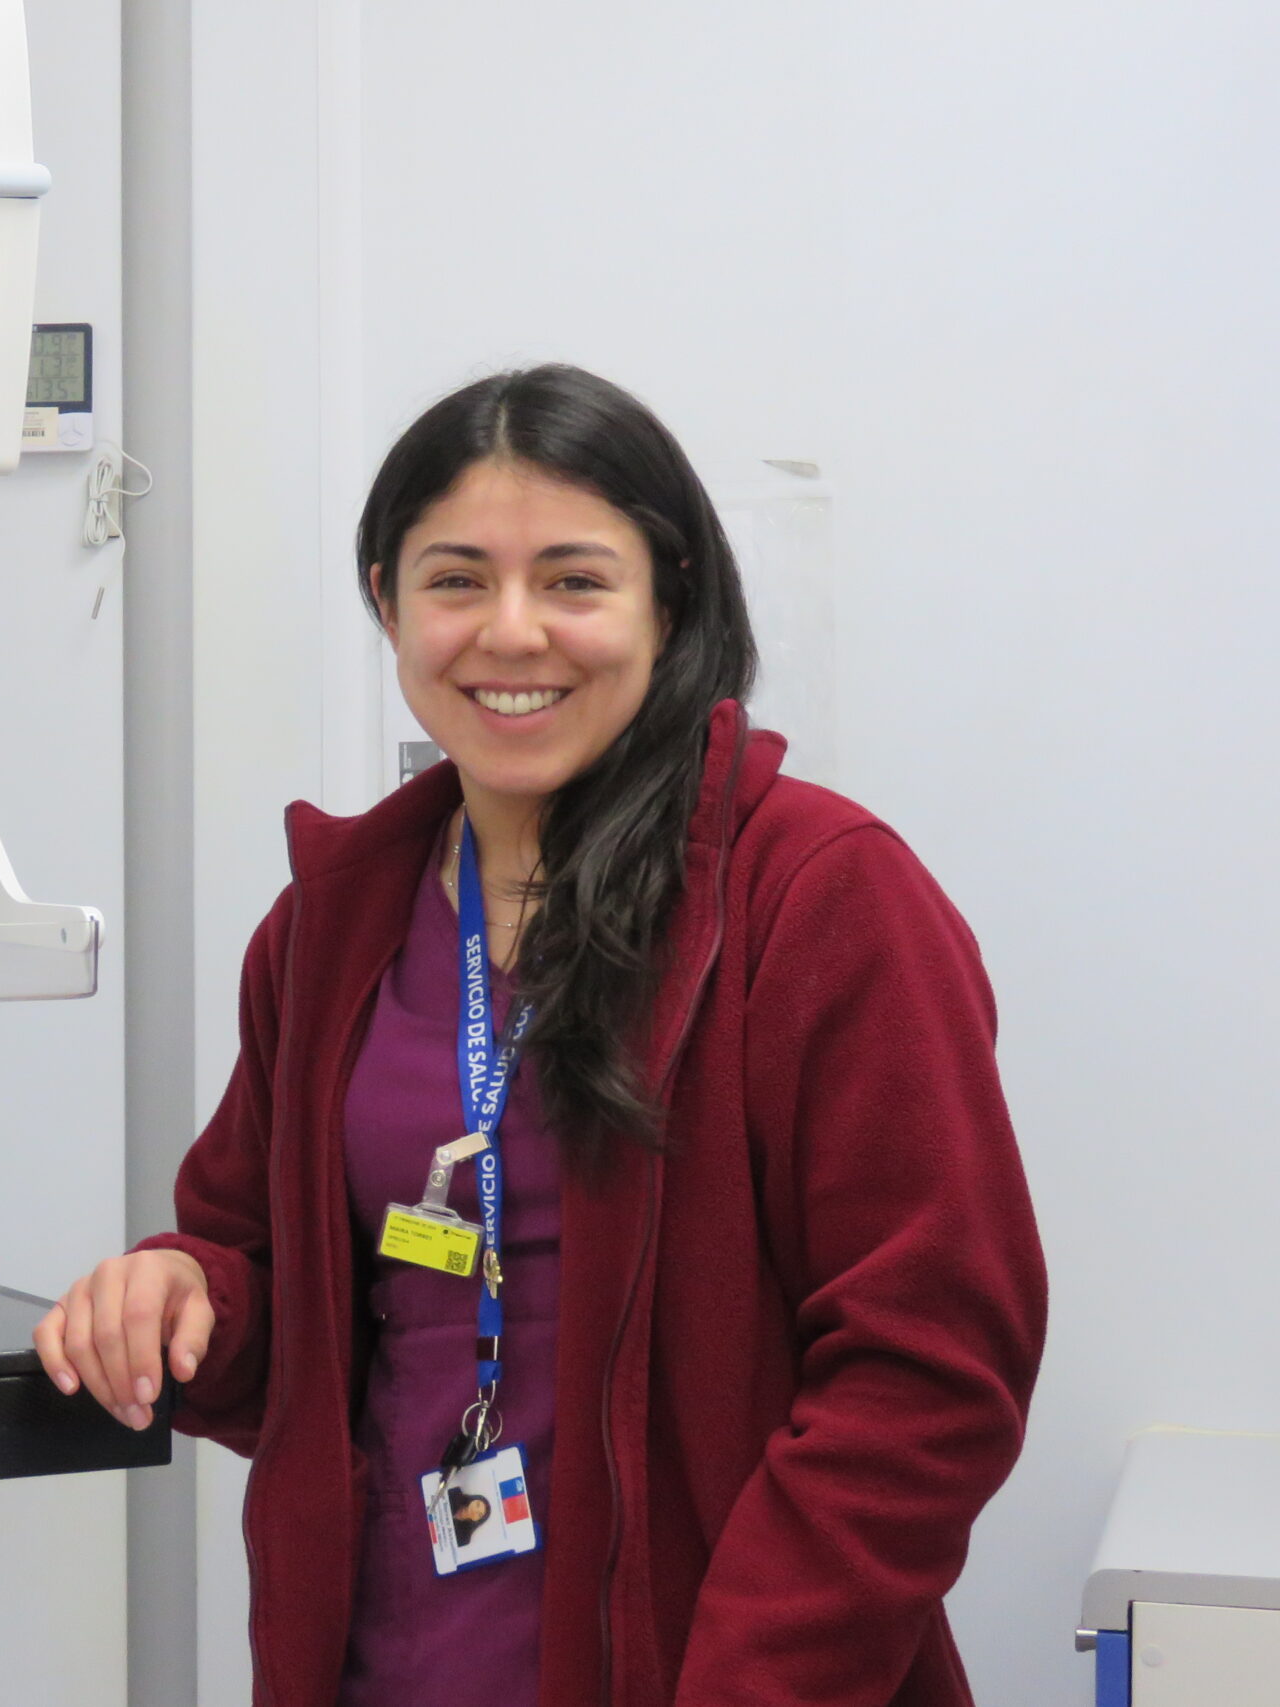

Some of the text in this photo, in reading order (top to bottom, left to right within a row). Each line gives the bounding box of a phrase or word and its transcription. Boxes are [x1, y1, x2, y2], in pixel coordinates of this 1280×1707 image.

[466, 934, 485, 1020] SERVICIO
[467, 1024, 486, 1048] DE
[482, 1154, 496, 1249] ERVICIO
